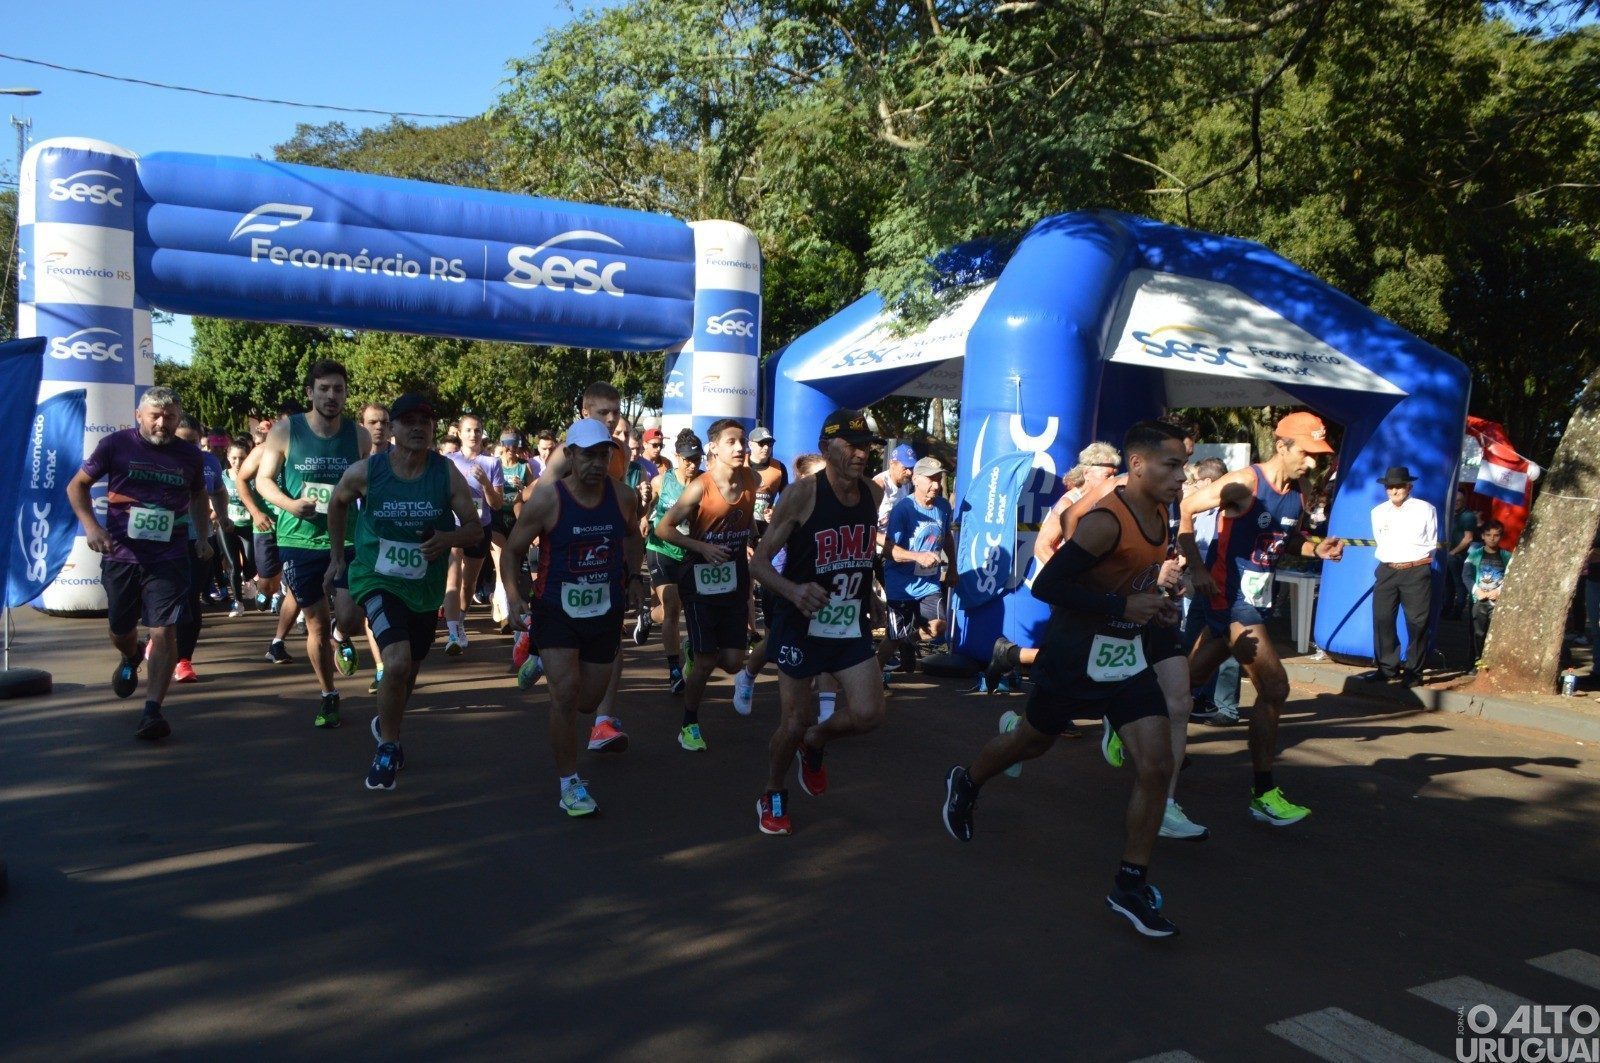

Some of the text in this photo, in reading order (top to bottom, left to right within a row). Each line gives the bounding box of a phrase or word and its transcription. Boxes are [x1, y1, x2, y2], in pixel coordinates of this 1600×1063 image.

[251, 237, 467, 283] Fecomércio RS
[46, 265, 131, 281] Fecomércio RS
[504, 245, 627, 298] Sesc
[294, 463, 327, 471] RODEIO
[304, 455, 348, 465] RÚSTICA
[373, 508, 444, 518] RODEIO BONITO
[382, 500, 434, 511] RÚSTICA
[134, 512, 169, 532] 558
[385, 545, 423, 568] 496
[700, 565, 731, 585] 693
[829, 571, 863, 601] 30
[567, 588, 603, 608] 661
[817, 604, 856, 627] 629
[1096, 643, 1137, 668] 523
